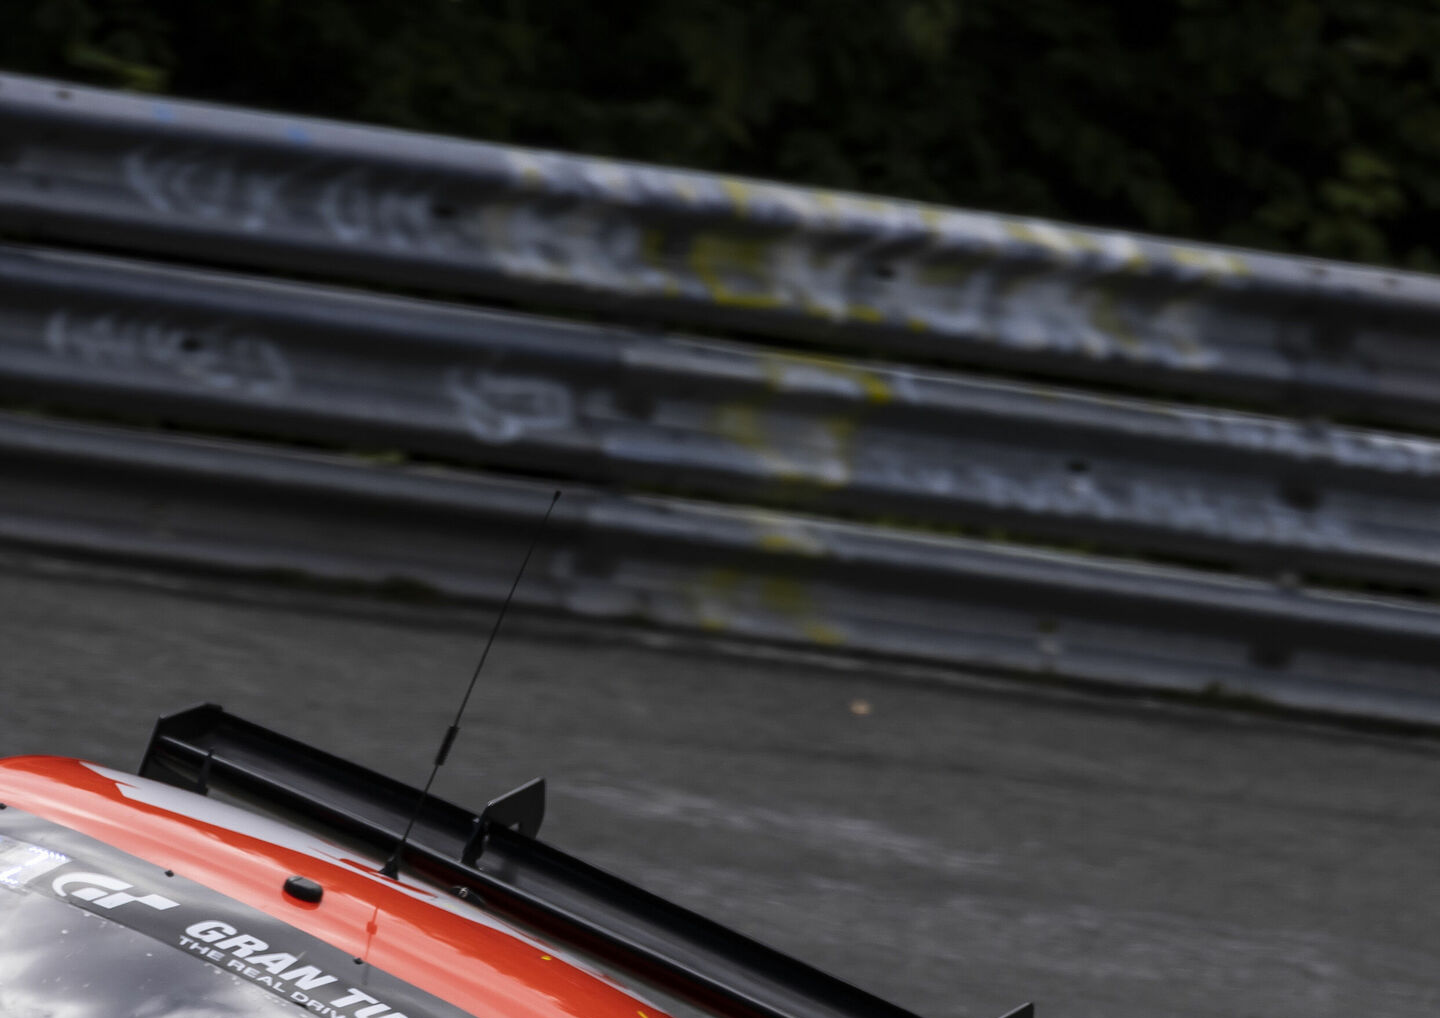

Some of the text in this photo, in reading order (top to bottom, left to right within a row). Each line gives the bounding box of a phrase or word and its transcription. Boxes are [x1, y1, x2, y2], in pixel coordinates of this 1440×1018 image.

[179, 936, 226, 962] THE
[227, 959, 286, 993] REAL
[185, 920, 339, 991] GRAN
